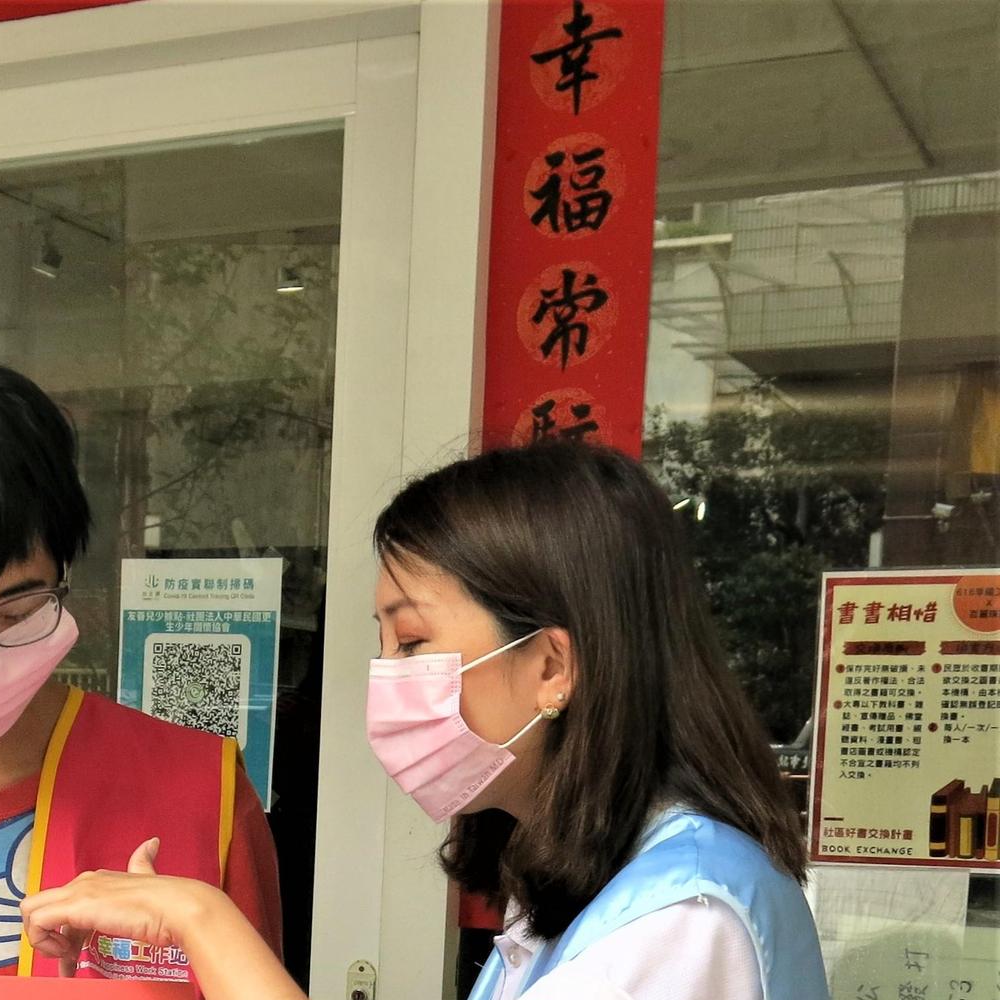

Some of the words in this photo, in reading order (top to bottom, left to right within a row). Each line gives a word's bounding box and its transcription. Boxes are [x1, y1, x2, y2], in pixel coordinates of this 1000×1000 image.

[837, 600, 938, 624] 書書相惜
[822, 845, 851, 853] BOOK
[856, 845, 913, 855] EXCHANGE
